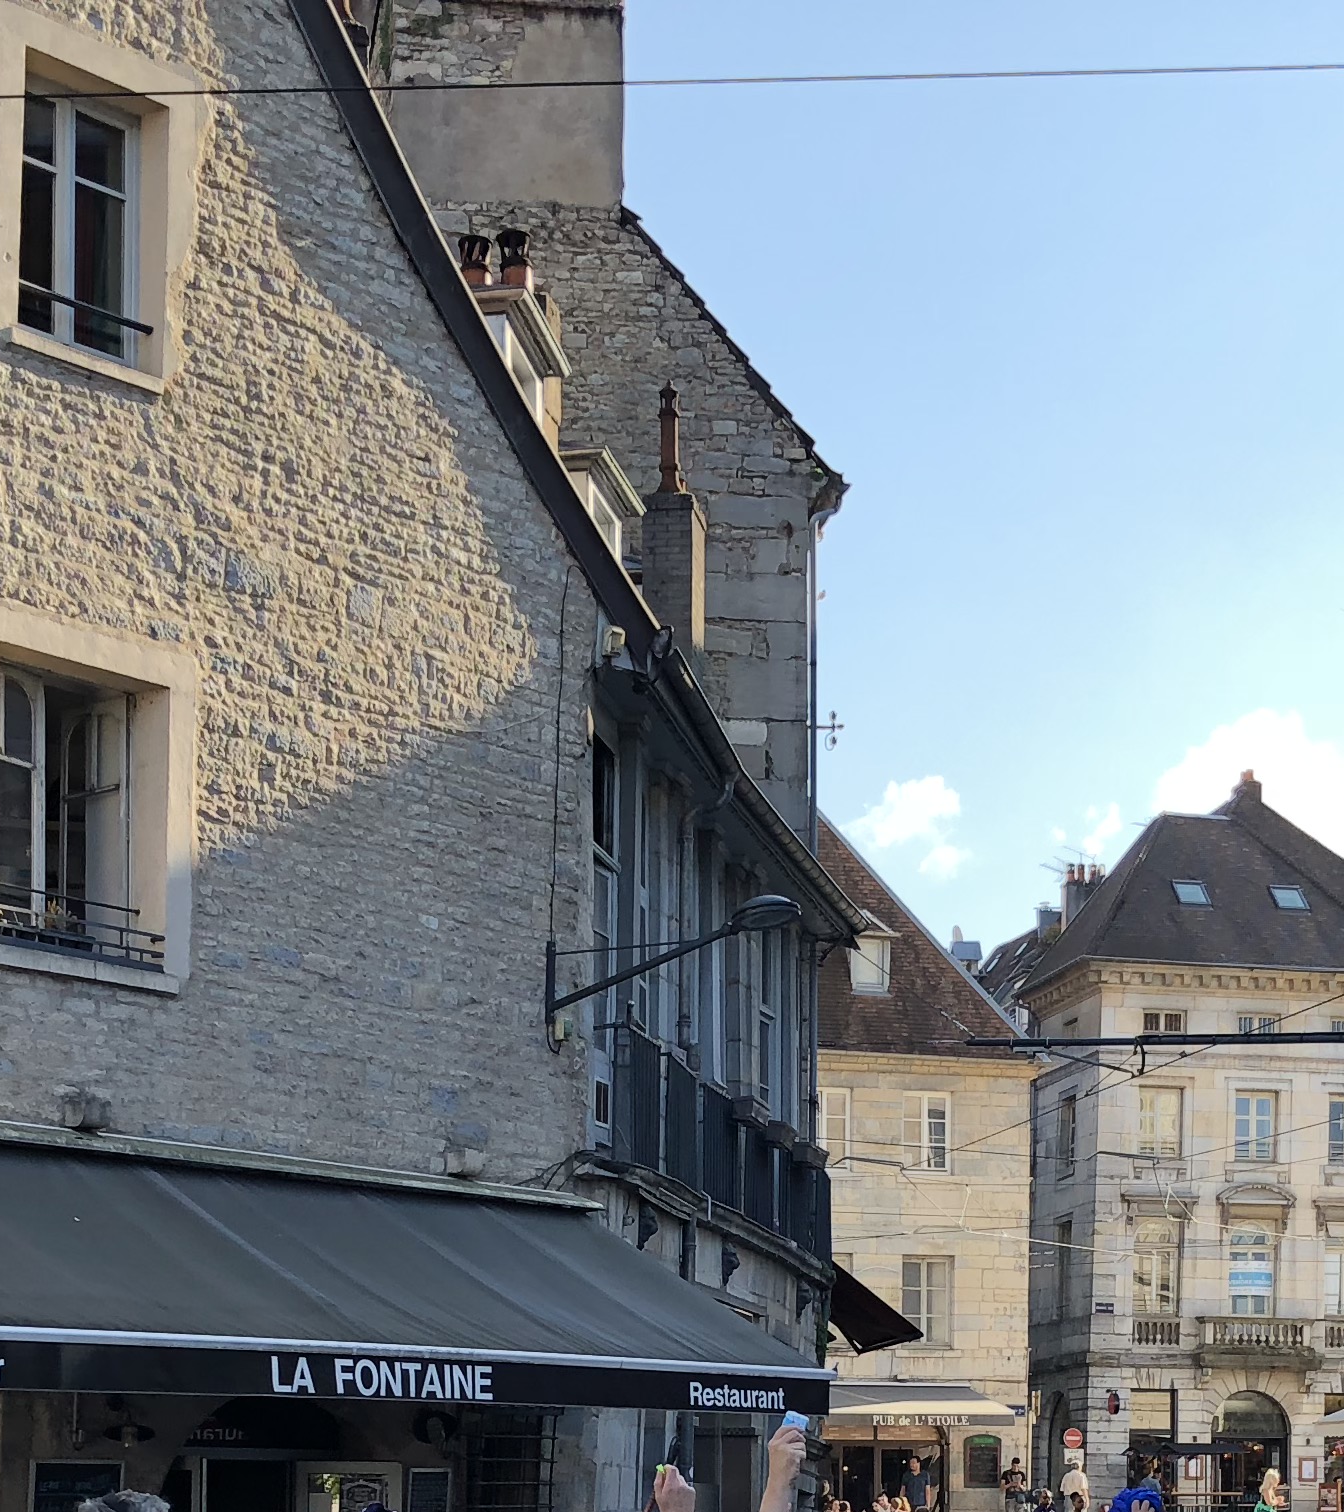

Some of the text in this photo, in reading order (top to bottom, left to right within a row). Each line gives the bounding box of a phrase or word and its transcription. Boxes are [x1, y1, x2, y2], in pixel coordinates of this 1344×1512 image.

[270, 1355, 494, 1401] LA FONTAINE
[689, 1381, 786, 1410] Restaurant
[872, 1414, 895, 1426] PUB
[898, 1415, 911, 1427] de
